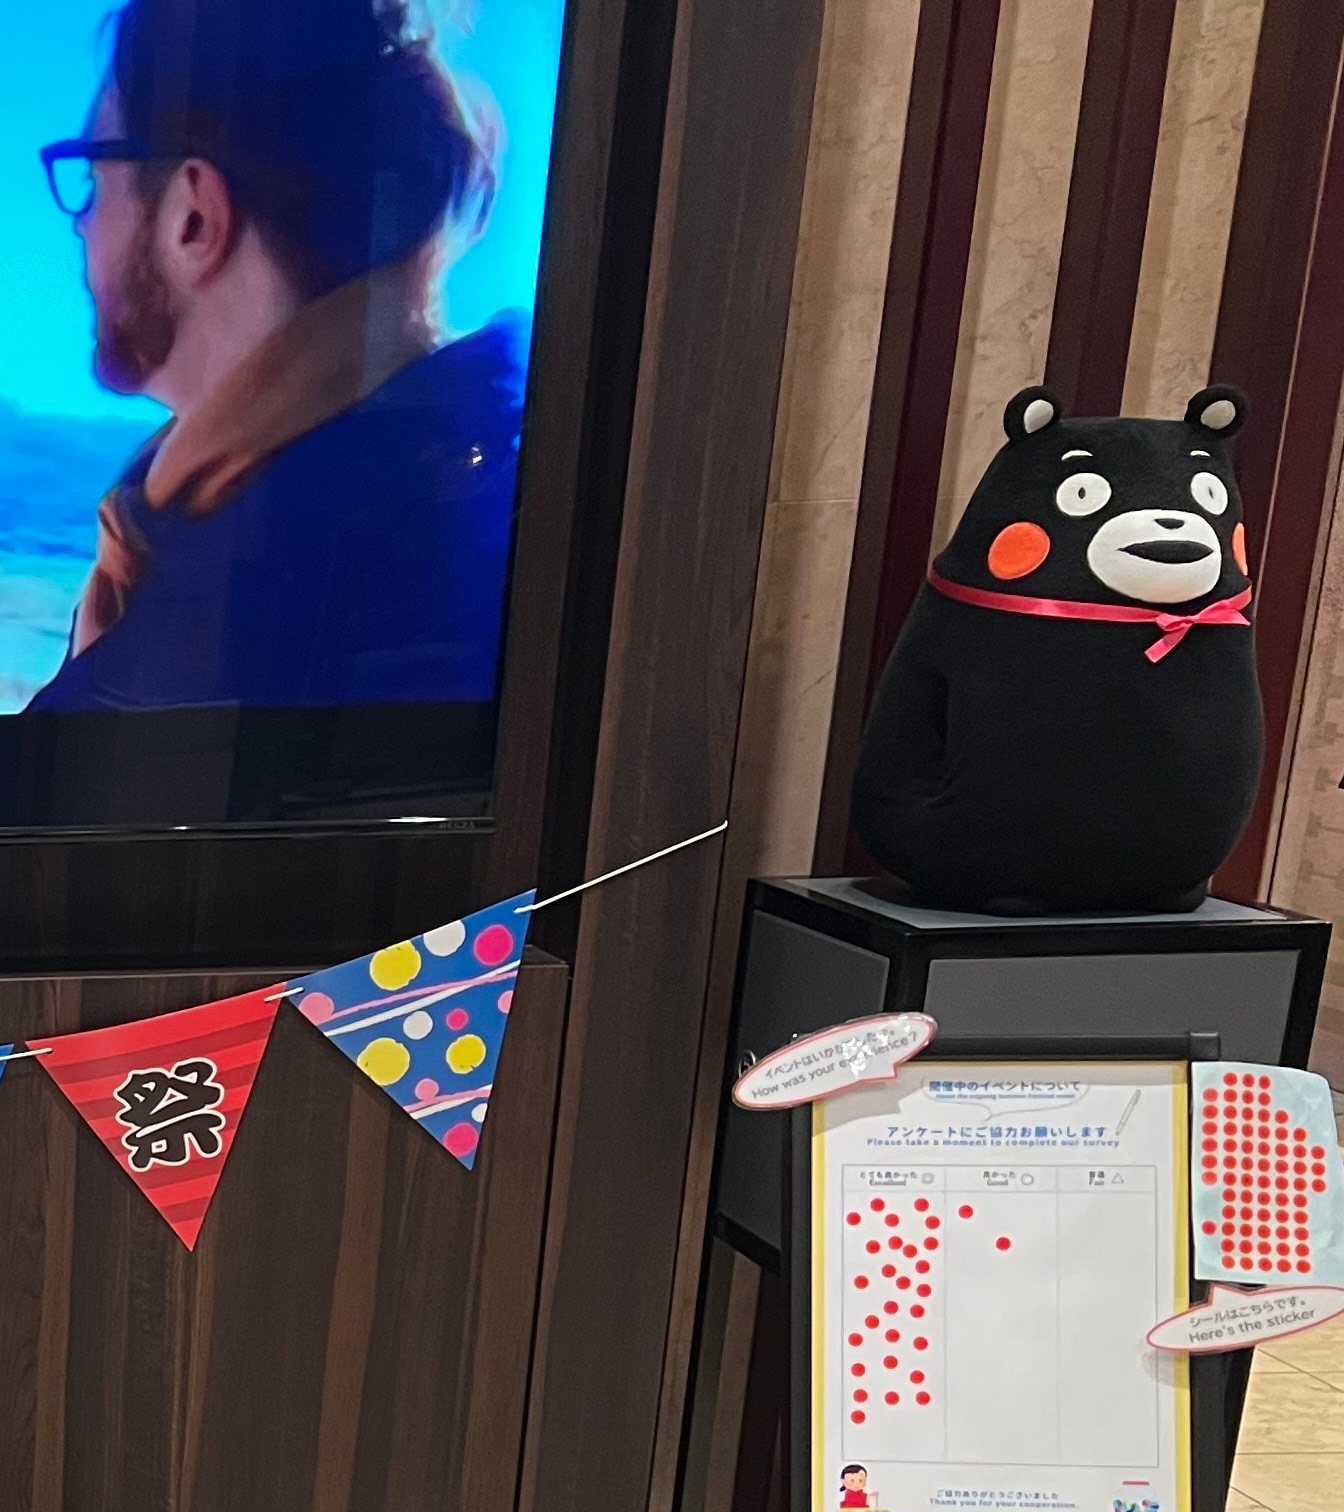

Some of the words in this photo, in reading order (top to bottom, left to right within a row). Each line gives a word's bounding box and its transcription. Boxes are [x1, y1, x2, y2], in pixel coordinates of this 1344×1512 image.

[752, 1083, 780, 1100] How
[783, 1075, 807, 1089] was
[809, 1062, 836, 1080] your
[115, 1057, 227, 1171] 祭
[1189, 1324, 1236, 1344] Here's
[1239, 1318, 1263, 1332] the
[1267, 1307, 1315, 1327] sticker
